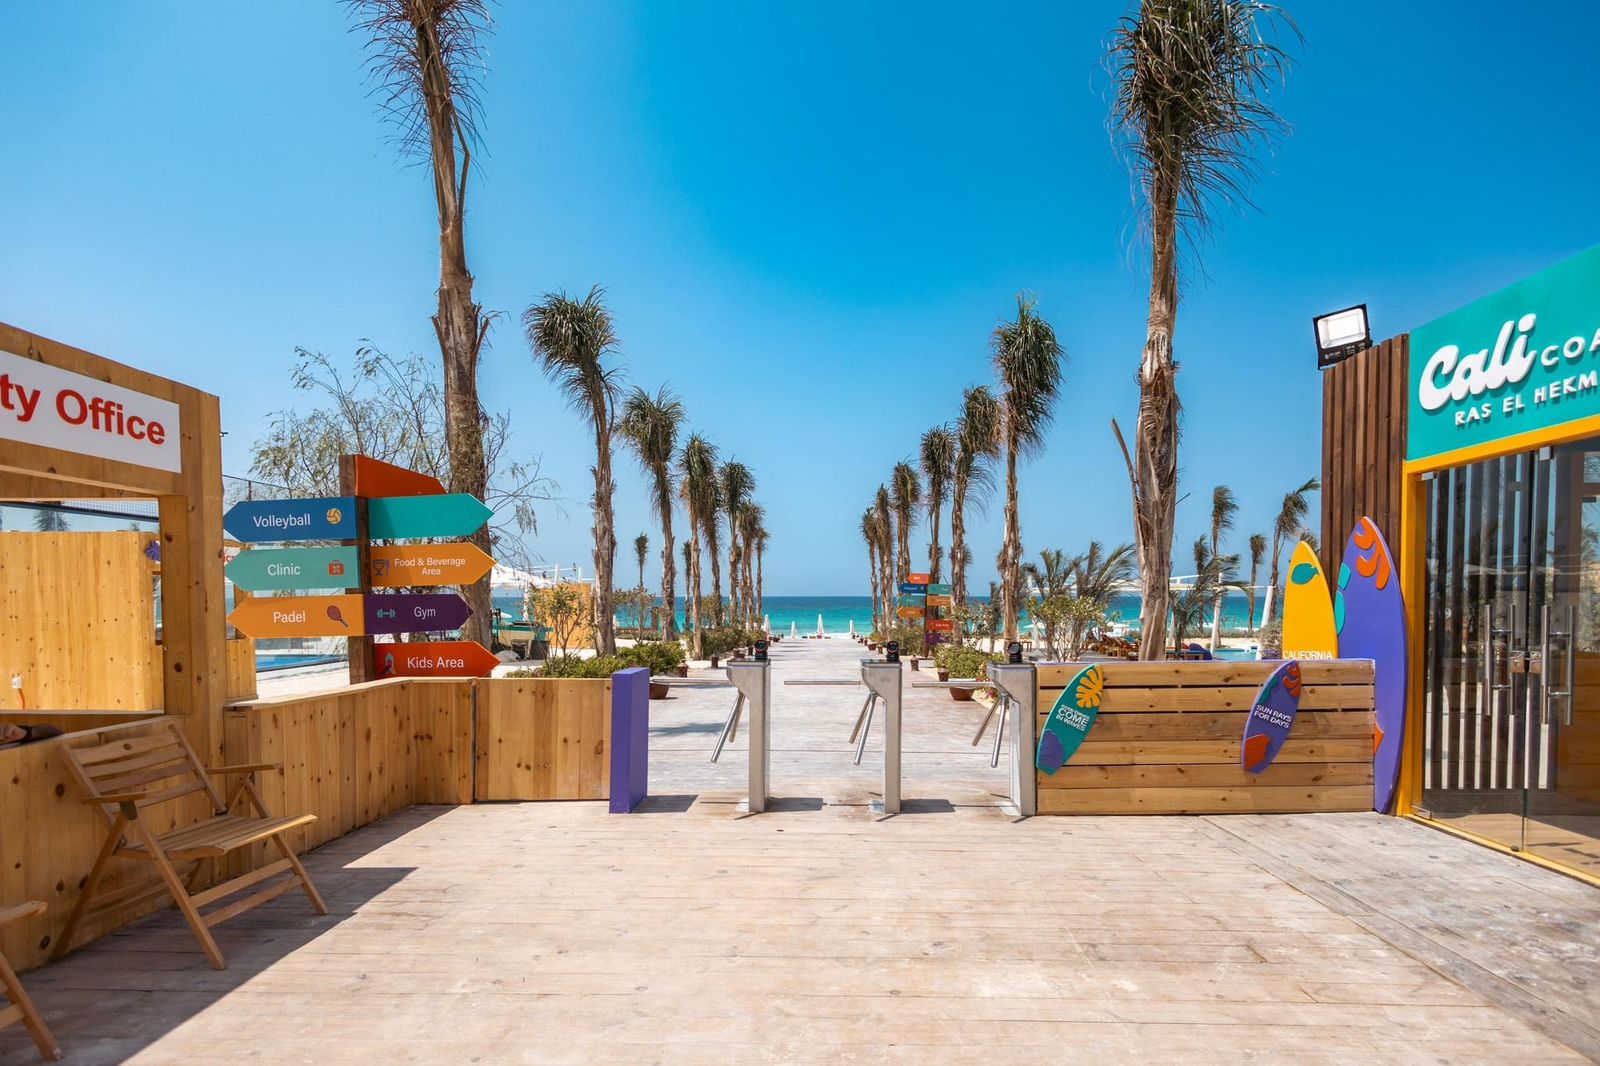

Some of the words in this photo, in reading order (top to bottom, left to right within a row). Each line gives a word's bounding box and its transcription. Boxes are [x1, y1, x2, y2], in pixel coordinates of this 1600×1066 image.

[1419, 313, 1537, 410] Cali
[56, 389, 165, 445] Office
[1455, 403, 1492, 425] RAS
[1502, 394, 1525, 413] EL
[253, 513, 311, 529] Volleyball
[267, 563, 301, 576] Clinic
[394, 558, 416, 567] Food
[417, 558, 424, 566] &
[426, 557, 466, 567] Beverage
[421, 568, 441, 576] Area
[273, 610, 306, 623] Padel
[413, 606, 436, 620] Gym
[407, 656, 433, 669] Kids
[436, 656, 465, 668] Area
[1282, 650, 1333, 660] CALIFORNIA
[1058, 707, 1089, 726] COME
[1253, 710, 1270, 721] FOR
[1270, 716, 1290, 728] DAYS
[1256, 704, 1273, 715] SUN
[1273, 710, 1292, 722] RAYS
